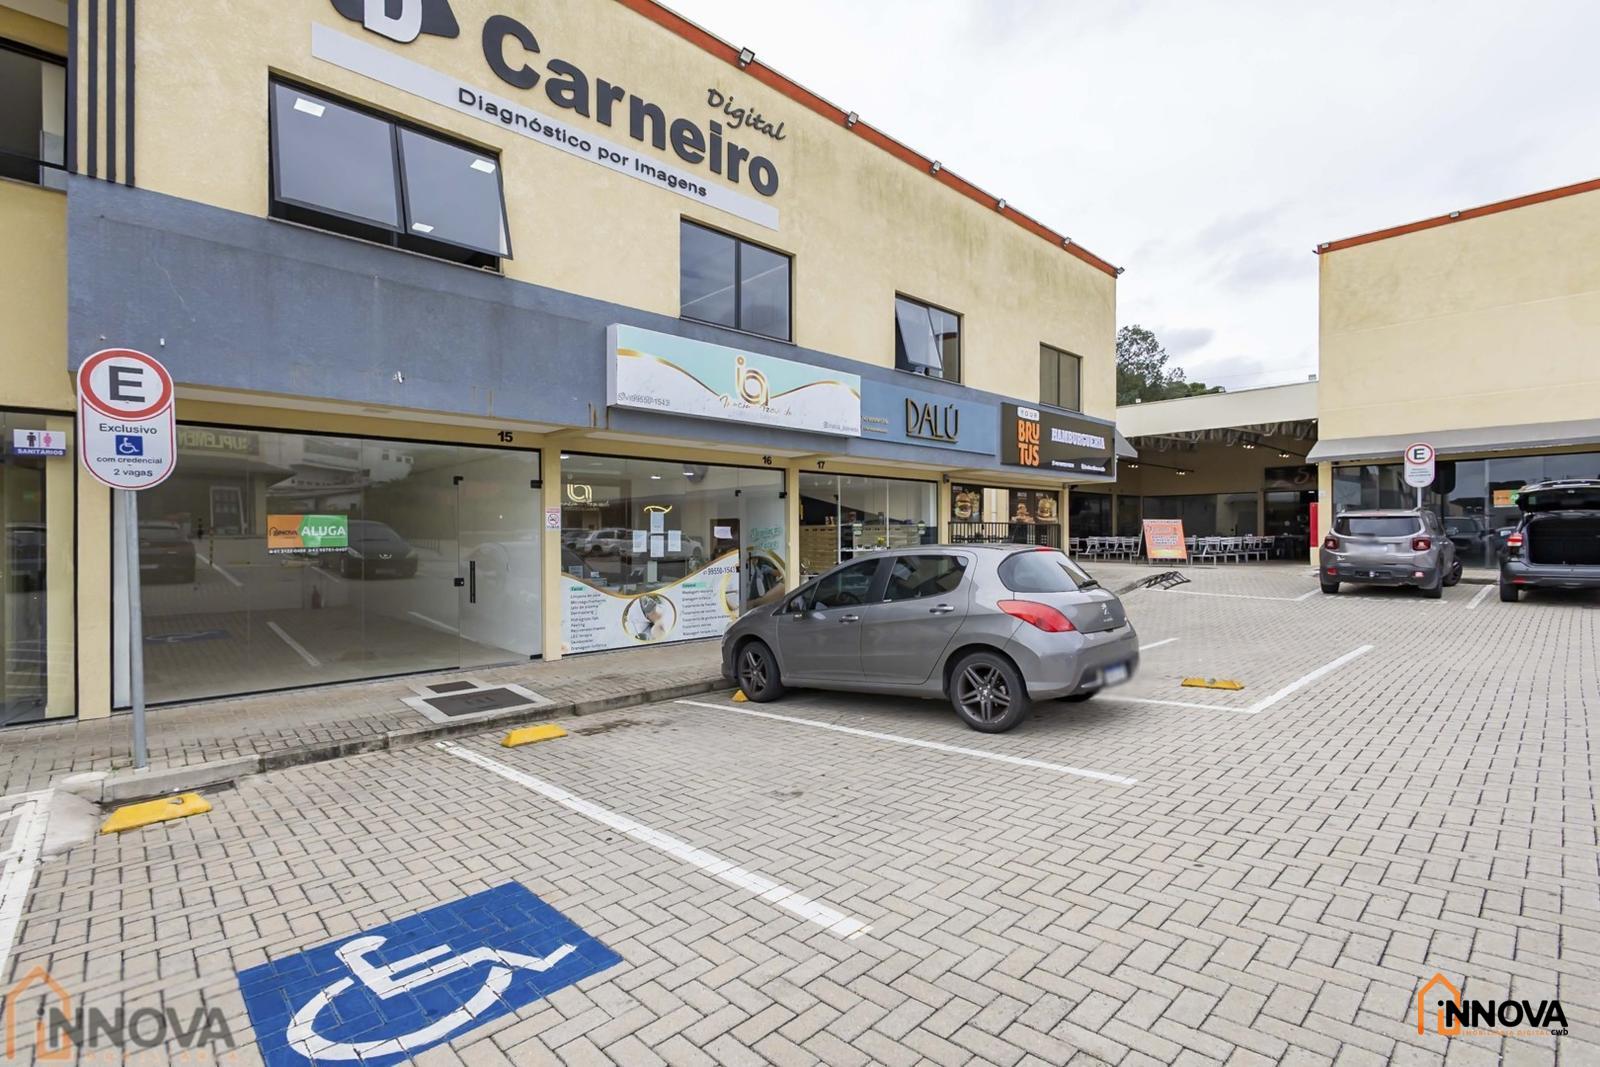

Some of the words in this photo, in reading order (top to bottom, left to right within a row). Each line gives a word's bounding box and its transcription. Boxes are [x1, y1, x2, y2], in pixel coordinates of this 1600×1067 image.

[482, 14, 780, 197] Carneiro
[707, 88, 787, 141] Digital
[458, 87, 592, 153] Diagnóstico
[598, 146, 629, 166] por
[635, 158, 708, 198] Imagens
[109, 365, 146, 403] E
[905, 397, 960, 441] DALÚ
[99, 423, 158, 434] Exclusivo
[1018, 420, 1040, 445] BRU
[497, 431, 514, 443] 15
[117, 456, 163, 464] credencial
[1018, 442, 1040, 467] TUS
[1413, 448, 1425, 460] E
[762, 456, 773, 465] 16
[817, 461, 825, 469] 17
[122, 469, 153, 478] vagas
[302, 526, 346, 537] ALUGA
